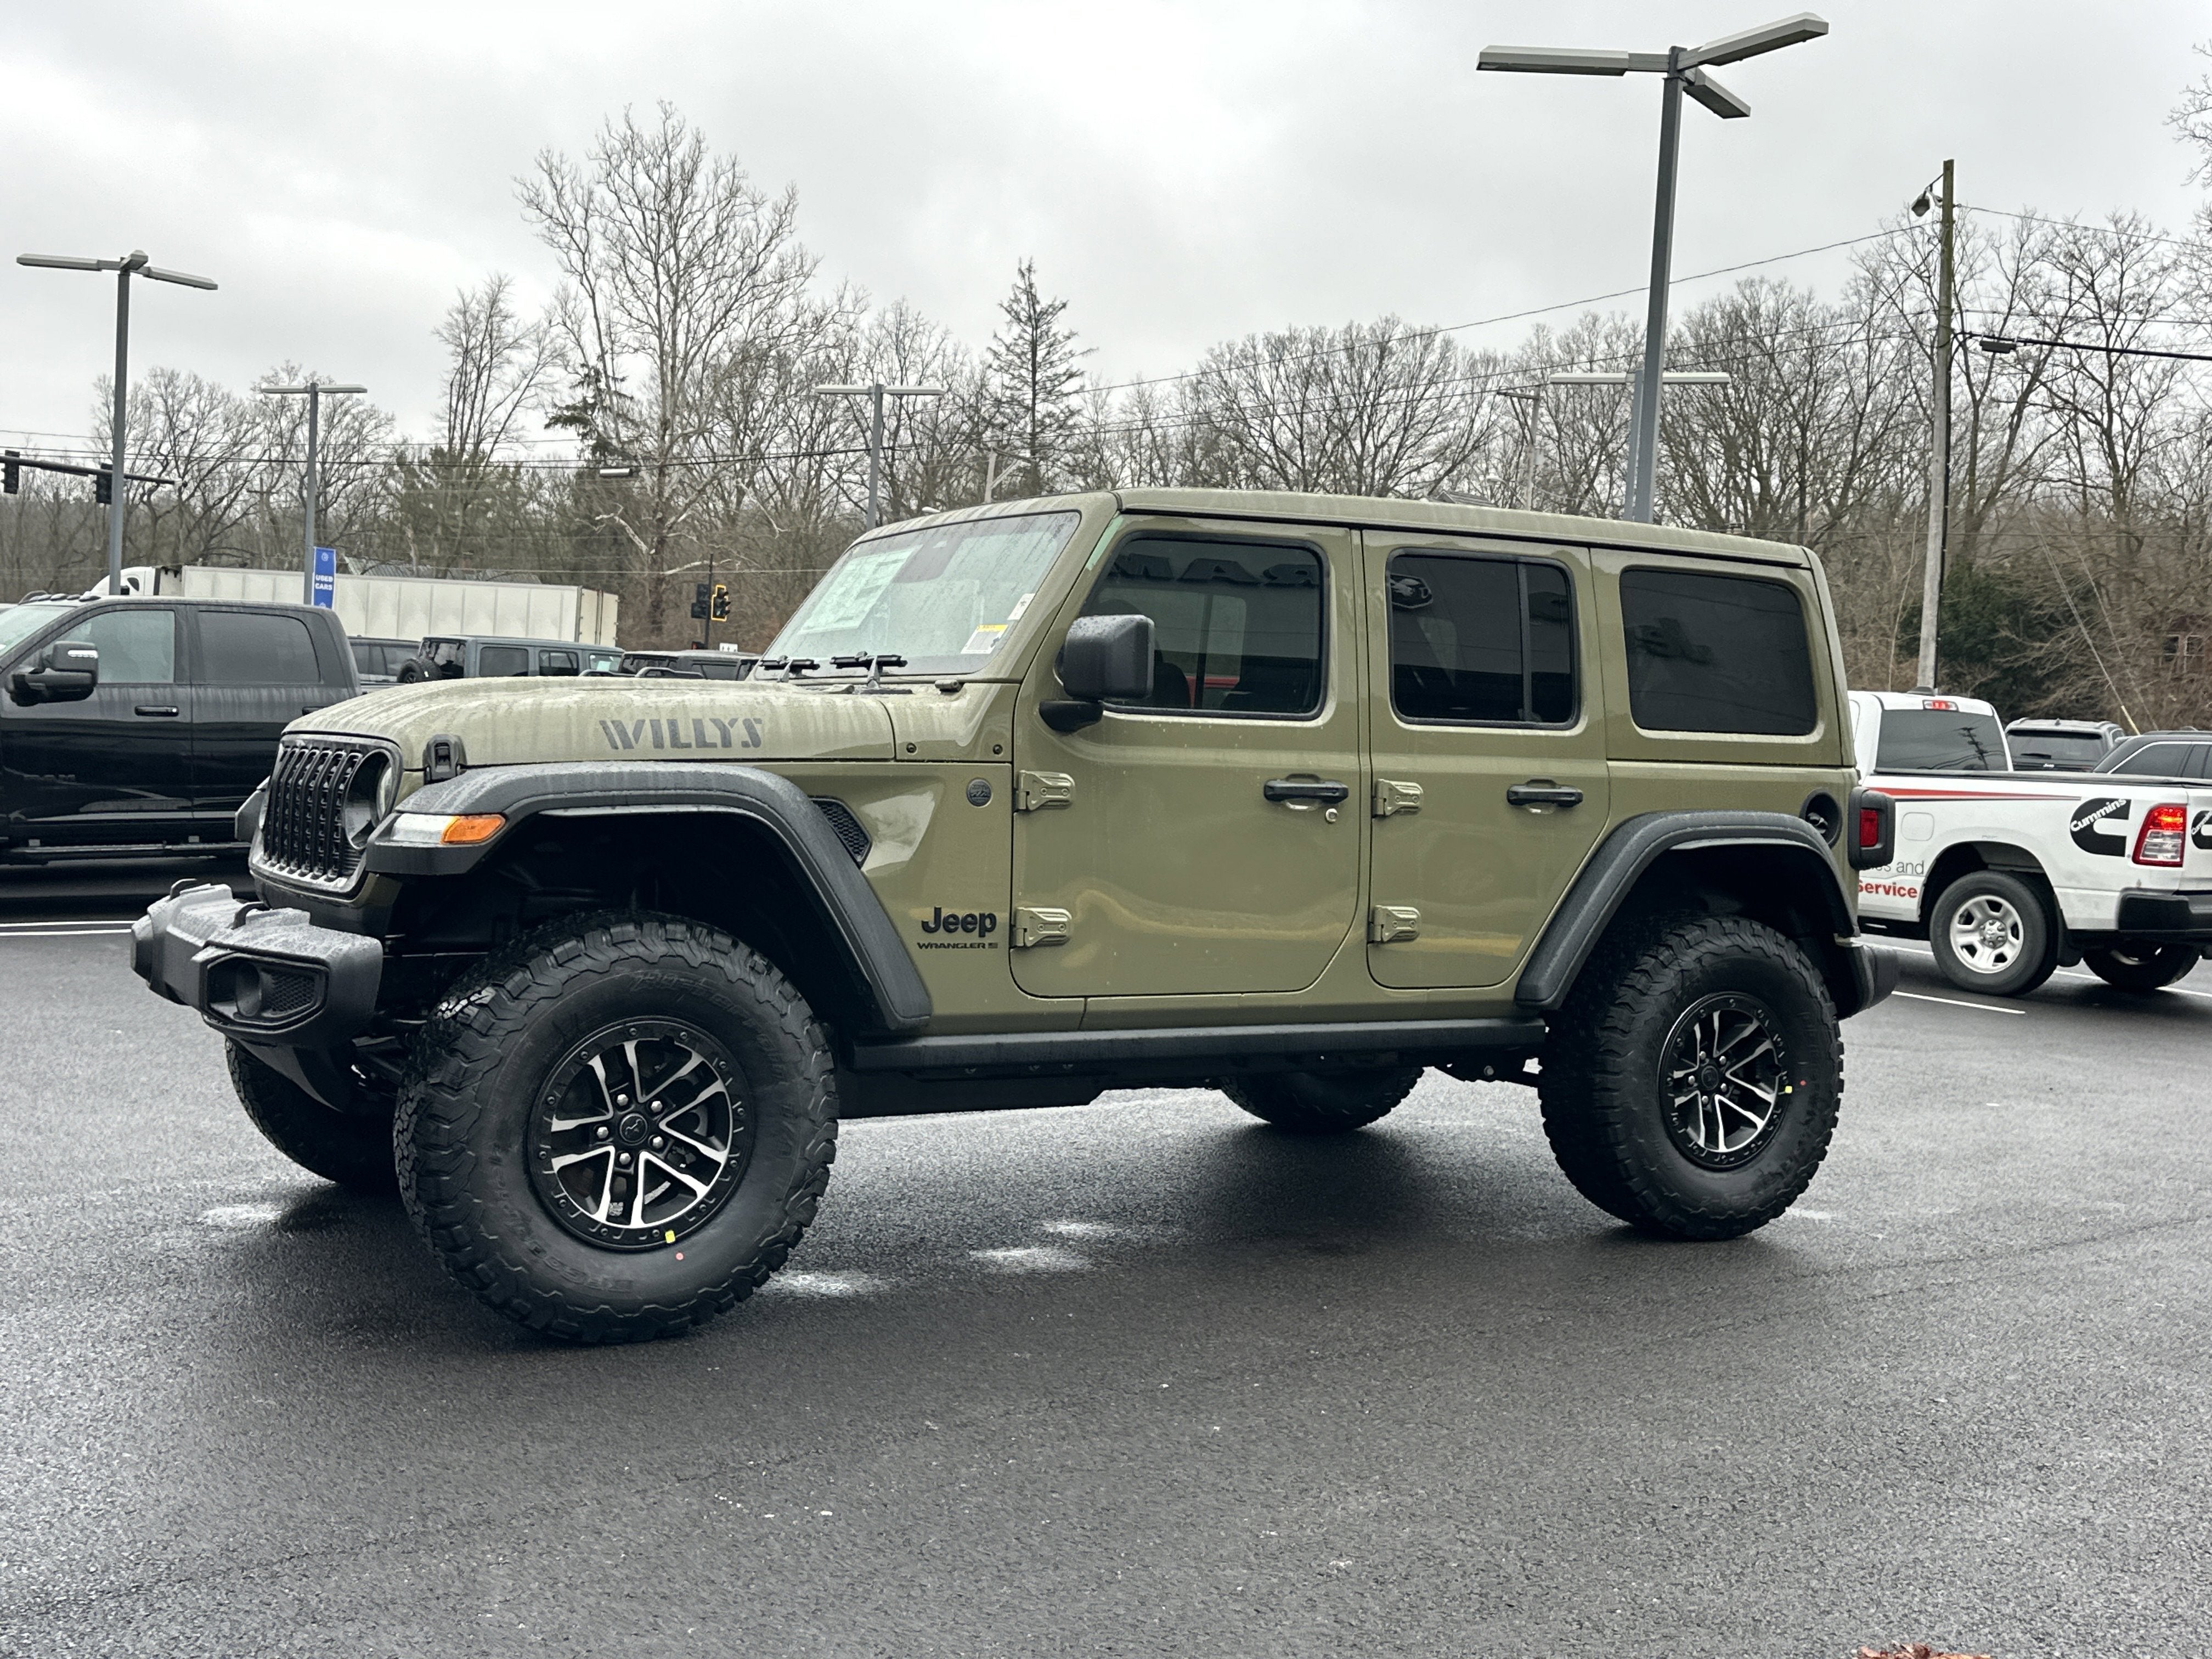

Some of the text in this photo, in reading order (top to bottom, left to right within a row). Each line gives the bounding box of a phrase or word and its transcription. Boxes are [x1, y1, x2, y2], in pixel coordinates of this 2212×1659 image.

[315, 574, 334, 583] USED
[599, 718, 763, 751] WILLYS
[2070, 799, 2126, 832] Cummins
[1896, 860, 1925, 875] and
[921, 906, 997, 938] Jeep
